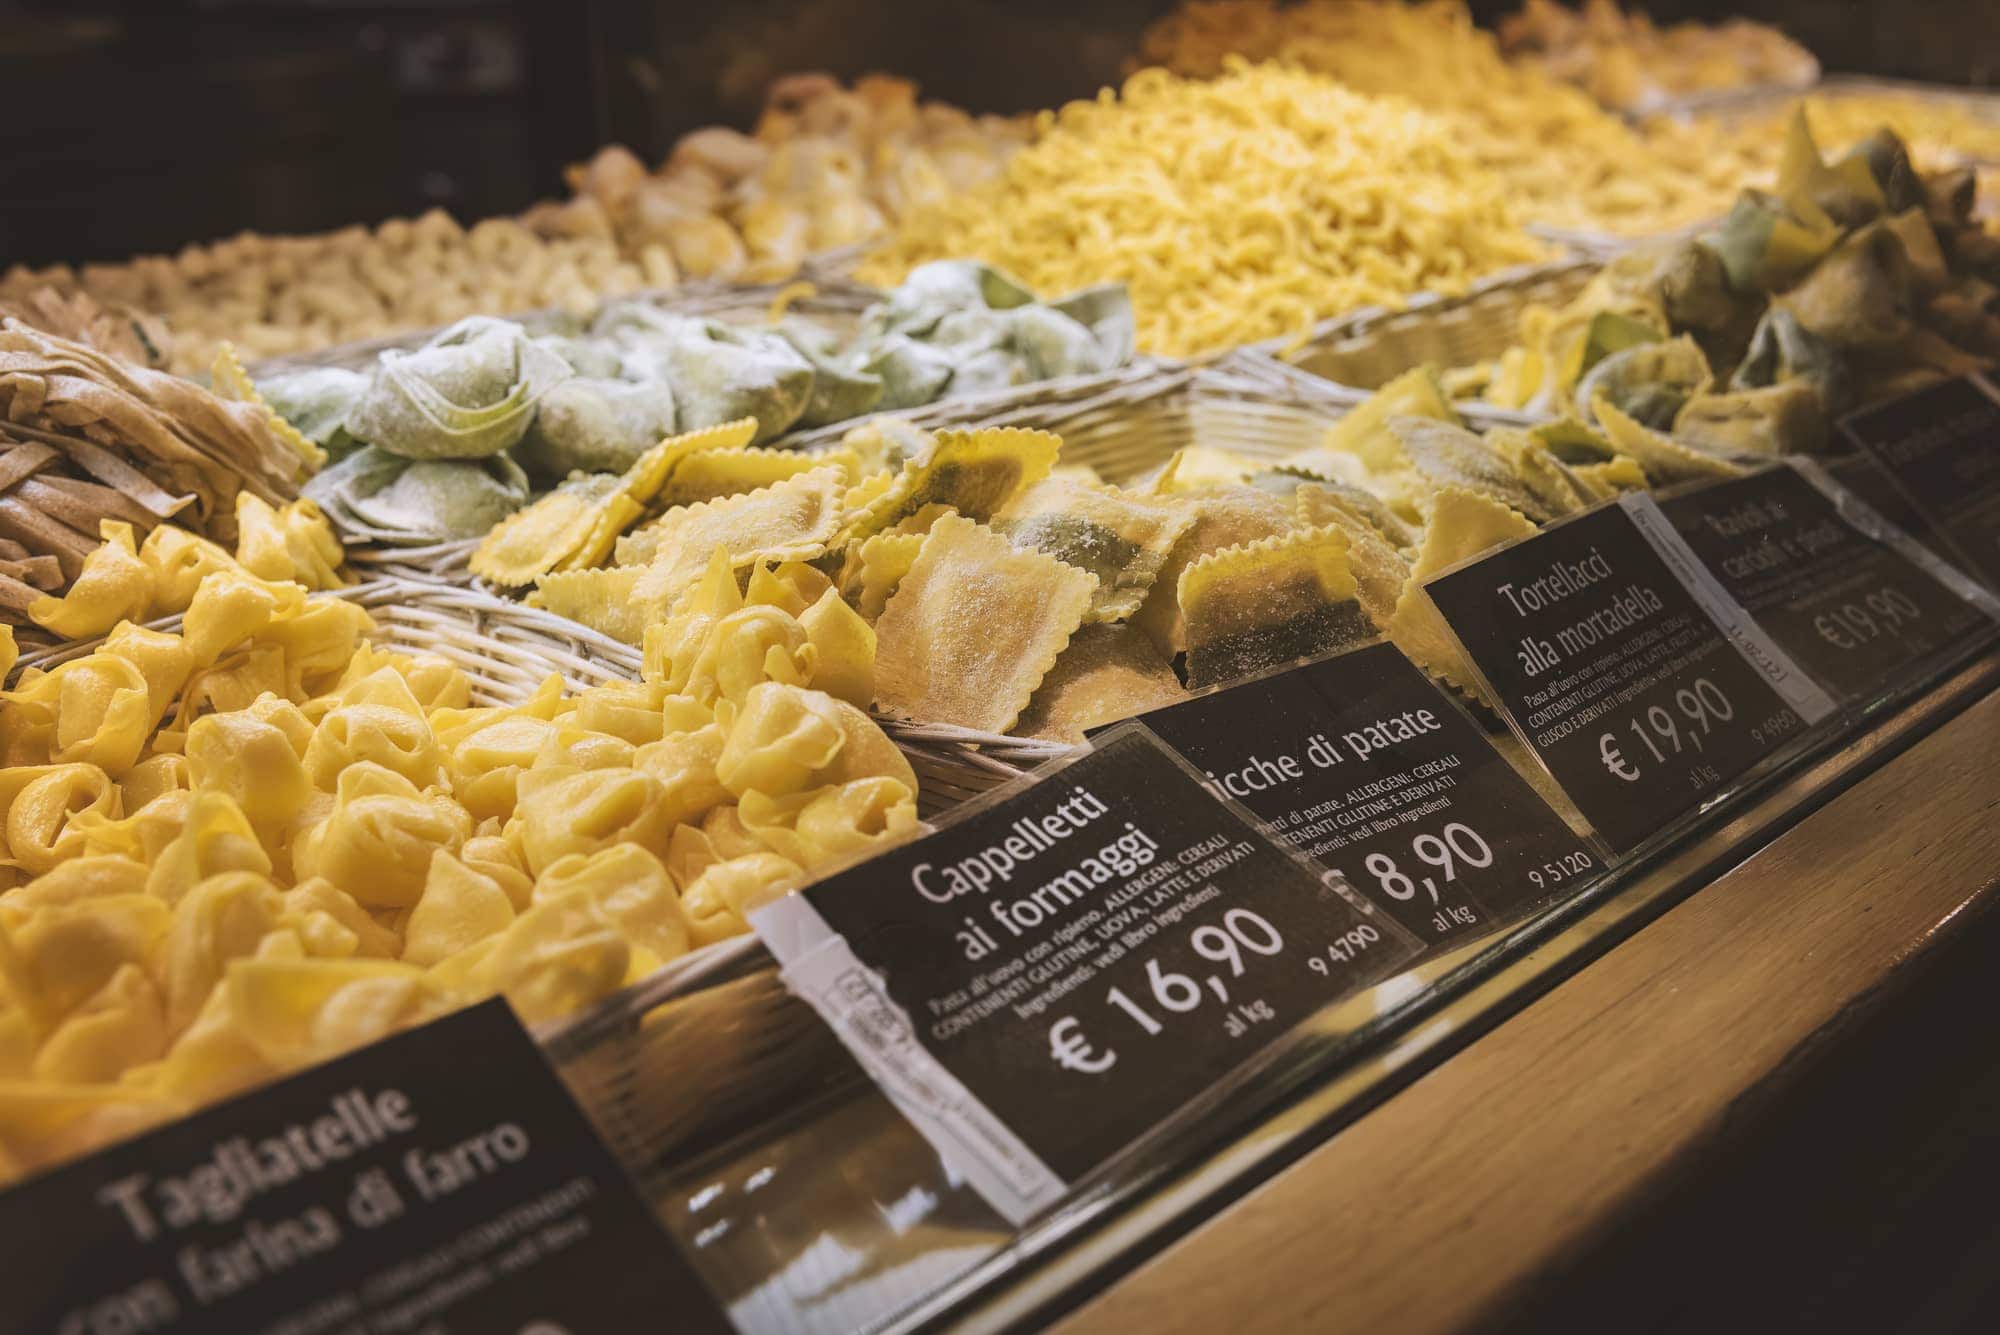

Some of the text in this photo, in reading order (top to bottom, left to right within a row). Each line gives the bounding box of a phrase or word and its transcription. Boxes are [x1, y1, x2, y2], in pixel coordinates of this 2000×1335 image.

[1497, 546, 1613, 617] Tortellacci
[1517, 584, 1664, 677] alla mortadella
[1523, 690, 1549, 709] Pasta
[1548, 674, 1580, 698] all'uovo
[1578, 667, 1594, 682] con
[1527, 691, 1585, 729] CONTENENTI
[1582, 671, 1621, 702] GLUTINE,
[1537, 720, 1573, 748] GUSCIO
[1572, 715, 1581, 728] E
[1579, 696, 1618, 725] DERIVATI
[1203, 708, 1442, 800] icche di patate
[1600, 678, 1733, 781] € 19,90
[1751, 728, 1766, 745] 9
[1289, 810, 1304, 825] di
[1303, 798, 1346, 823] patate.
[1346, 772, 1413, 805] ALLERGENI:
[1412, 754, 1461, 780] CEREALI
[1336, 798, 1392, 828] GLUTINE
[1391, 794, 1402, 808] E
[1401, 774, 1457, 805] DERIVATI
[911, 786, 1109, 903] Cappelletti
[1306, 795, 1452, 859] edienti: vedi libro ingredienti
[1365, 822, 1493, 905] 8,90
[956, 822, 1159, 960] ai formaggi
[1024, 941, 1053, 963] con
[1105, 861, 1180, 912] ALLERGENI:
[1177, 833, 1230, 866] CEREALI
[1528, 851, 1593, 889] 9 5120
[1028, 938, 1099, 984] GLUTINE,
[1095, 904, 1149, 941] UOVA,
[1144, 874, 1191, 906] LATTE
[1186, 867, 1201, 884] E
[1195, 841, 1255, 879] DERIVATI
[1094, 942, 1127, 969] vedi
[1121, 922, 1158, 949] libro
[1154, 883, 1221, 928] ingredienti
[1431, 904, 1477, 932] al kg
[1308, 924, 1380, 976] 9 4790
[1049, 908, 1284, 1073] € 16,90
[1224, 999, 1276, 1038] al kg
[99, 1087, 417, 1242] Tagliatelle
[404, 1122, 532, 1200] farro
